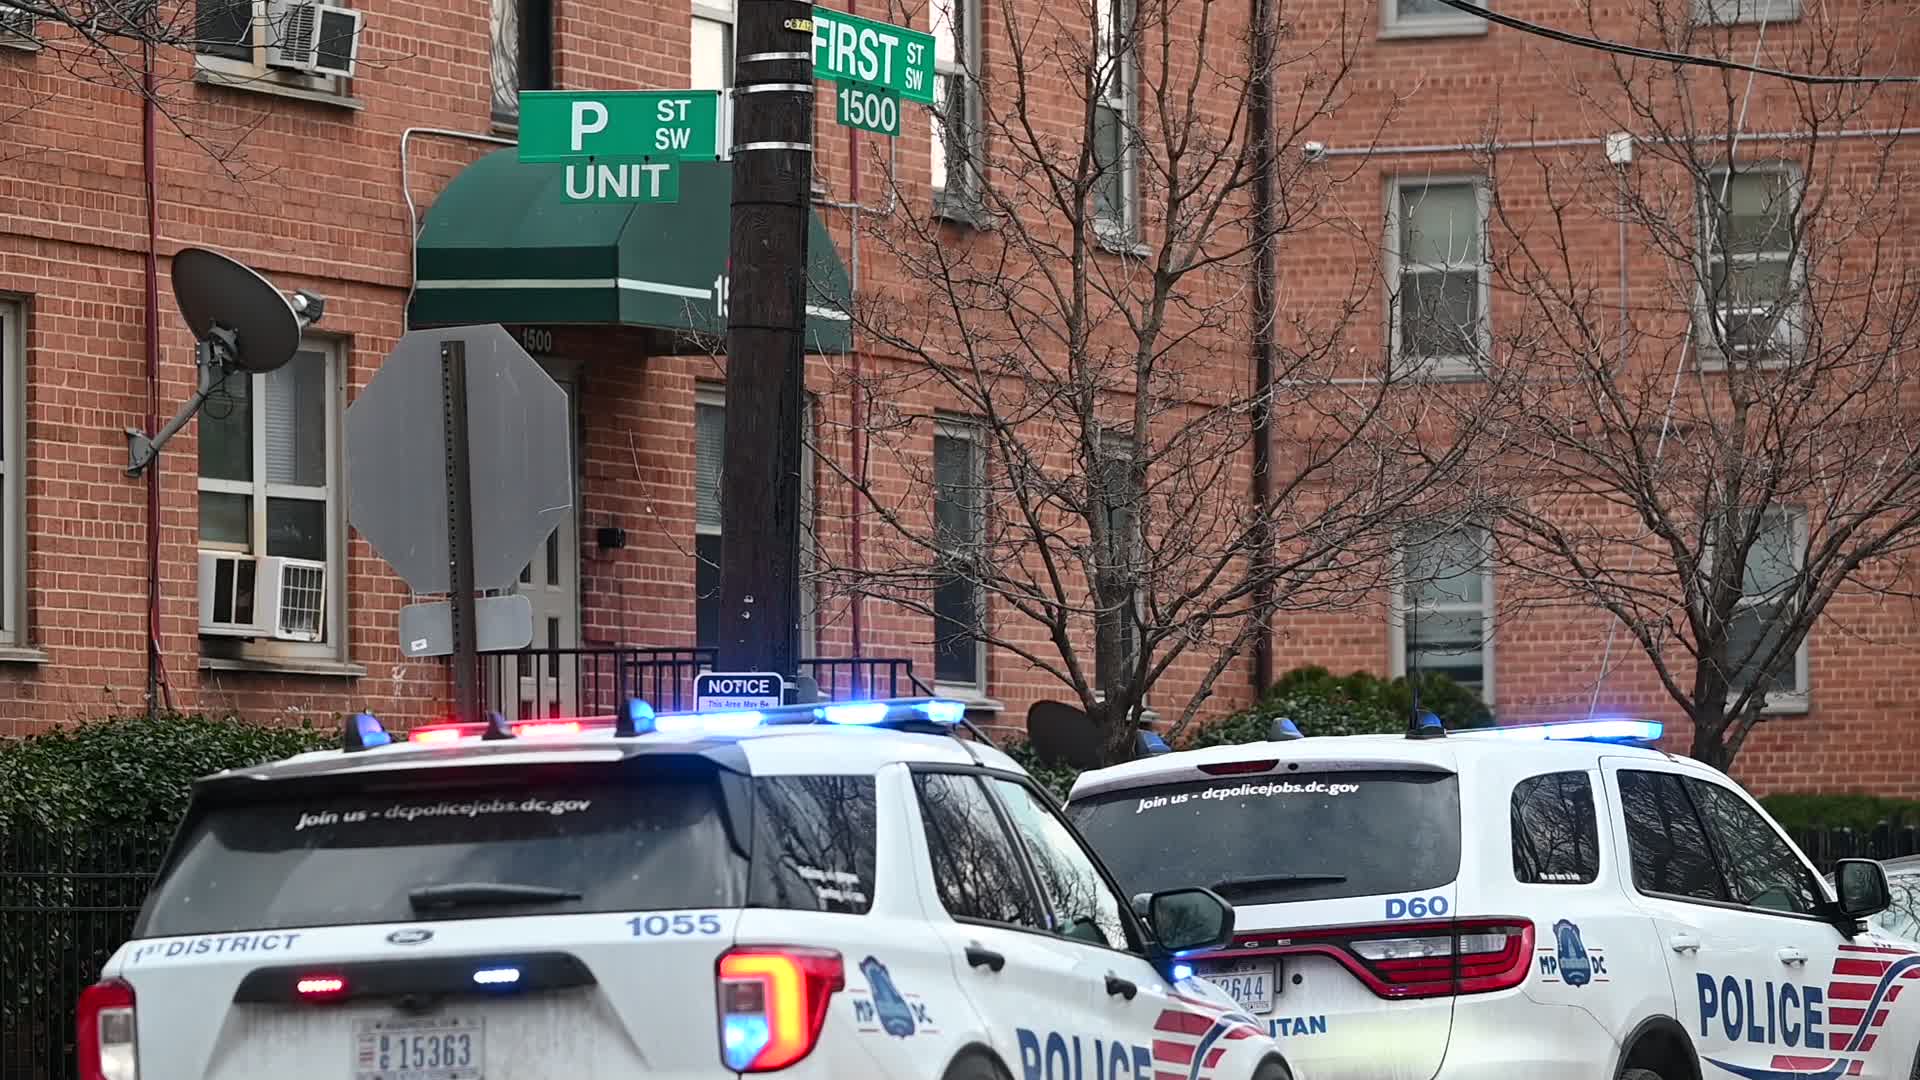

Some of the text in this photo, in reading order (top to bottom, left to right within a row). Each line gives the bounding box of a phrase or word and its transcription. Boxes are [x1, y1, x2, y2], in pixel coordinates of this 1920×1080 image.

[812, 16, 898, 84] FIRST
[906, 42, 924, 65] ST
[905, 67, 923, 91] SW
[656, 99, 691, 122] ST
[840, 88, 897, 132] 1500
[571, 101, 608, 151] P
[655, 128, 690, 150] SW
[566, 164, 670, 199] UNIT
[522, 328, 551, 352] 1500
[708, 680, 769, 694] NOTICE
[1136, 796, 1167, 814] Join
[1171, 794, 1189, 805] us
[1202, 781, 1359, 801] dcpolicejobs.dc.gov
[295, 811, 339, 831] Join
[343, 811, 367, 822] us
[384, 798, 592, 821] dcpolicejobs.dc.gov
[1385, 895, 1449, 919] D60
[625, 914, 721, 936] 1055
[165, 934, 302, 957] DISTRICT
[1539, 956, 1608, 975] MP DC
[1696, 972, 1825, 1049] POLICE
[400, 1034, 471, 1069] 15363
